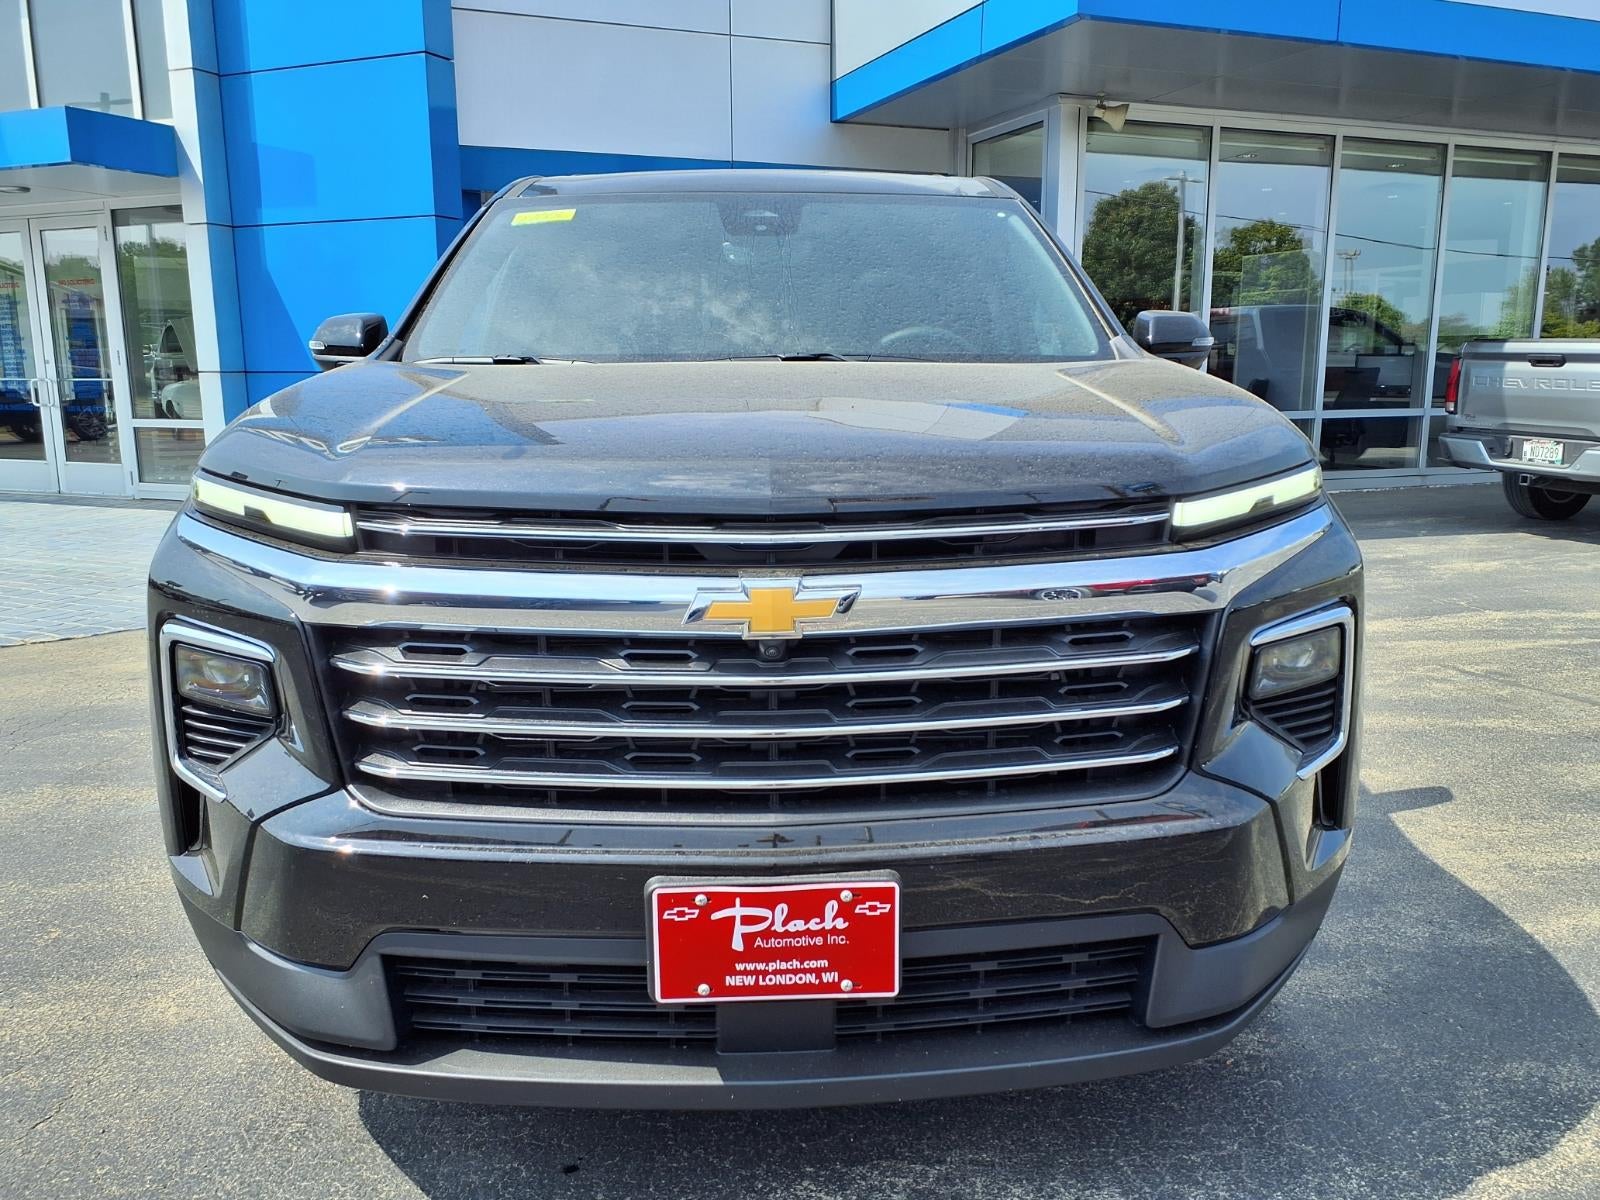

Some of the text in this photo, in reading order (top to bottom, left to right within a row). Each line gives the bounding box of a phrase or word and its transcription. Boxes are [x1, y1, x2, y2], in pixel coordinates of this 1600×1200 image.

[710, 897, 849, 952] Plach
[754, 933, 850, 949] Automotive Inc.
[735, 958, 829, 972] www.plach.com
[725, 971, 839, 986] NEW LONDON, WI
